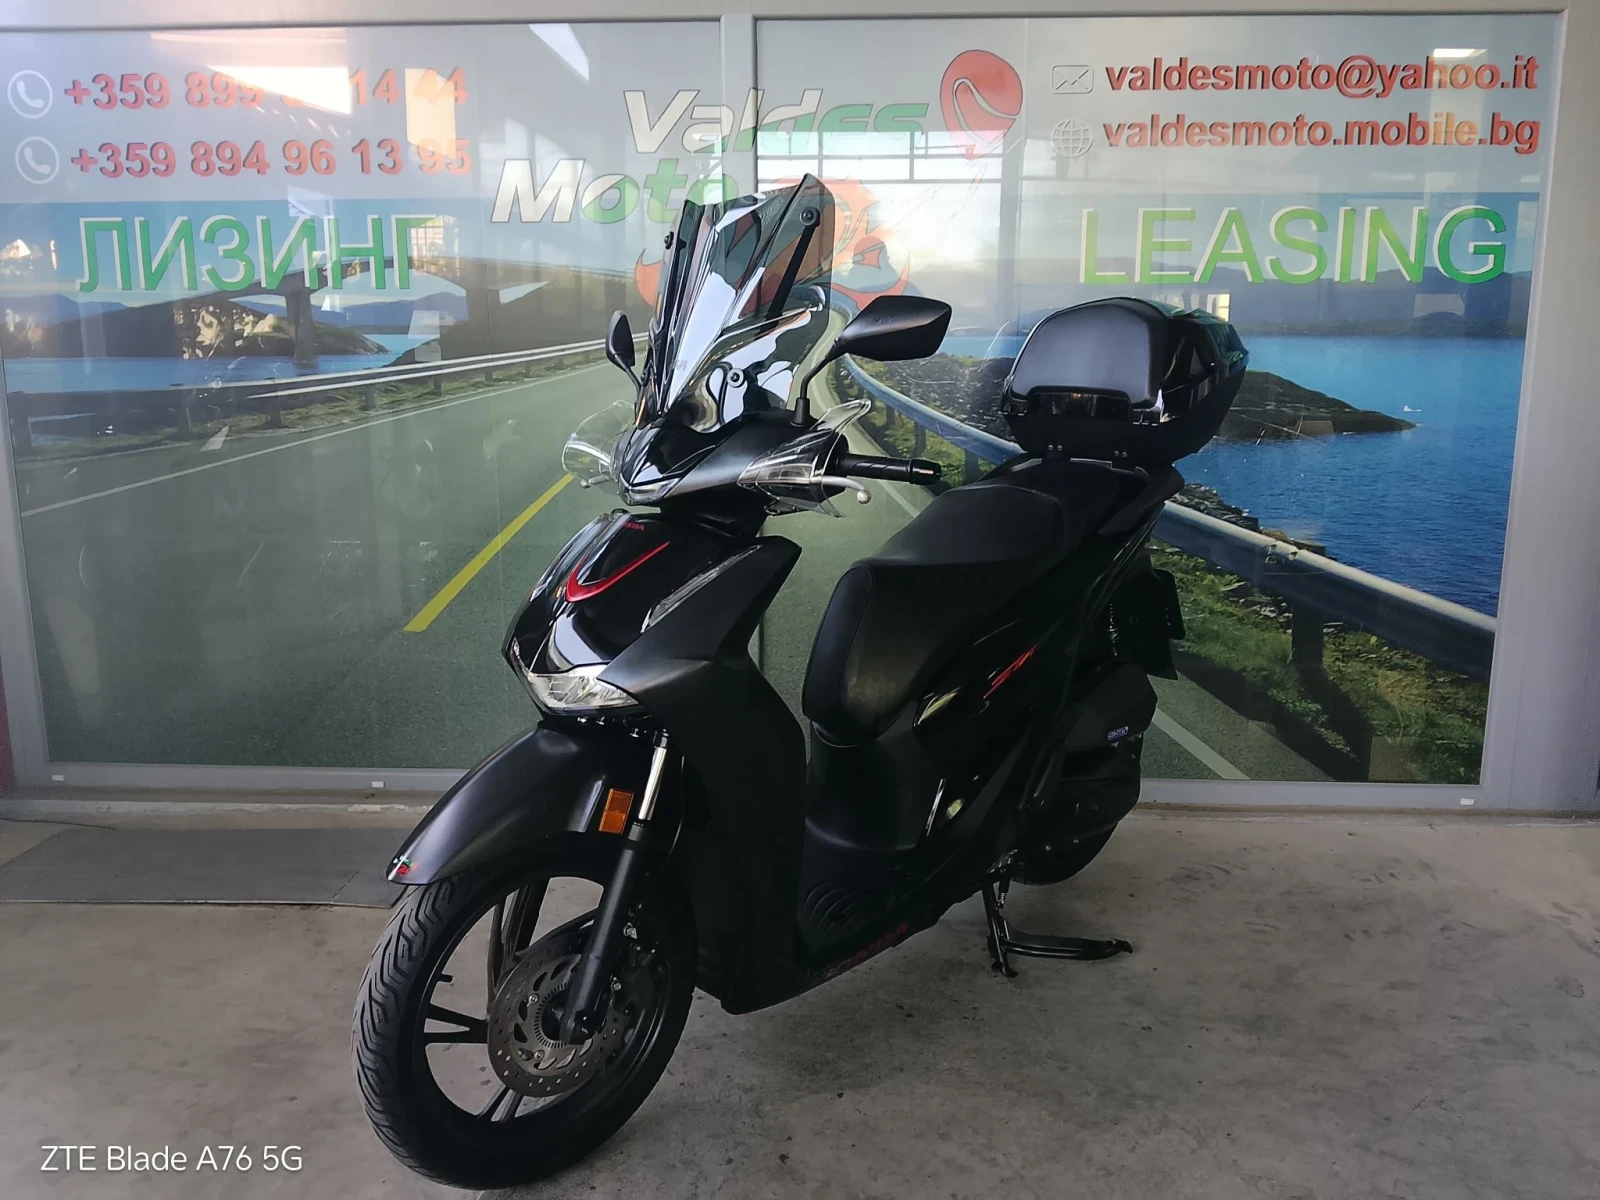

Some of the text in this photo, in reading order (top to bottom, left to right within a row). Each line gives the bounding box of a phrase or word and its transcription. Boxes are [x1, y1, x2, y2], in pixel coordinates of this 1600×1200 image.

[64, 73, 171, 110] +359
[349, 68, 400, 106] 14
[1105, 55, 1539, 98] valdesmoto@yahoo.it
[623, 88, 929, 154] Valdes
[1103, 112, 1541, 154] valdesmoto.mobile.bg
[71, 138, 472, 178] +359 894 96 13 95
[76, 214, 437, 292] ЛИЗИНГ
[1079, 206, 1506, 284] LEASING
